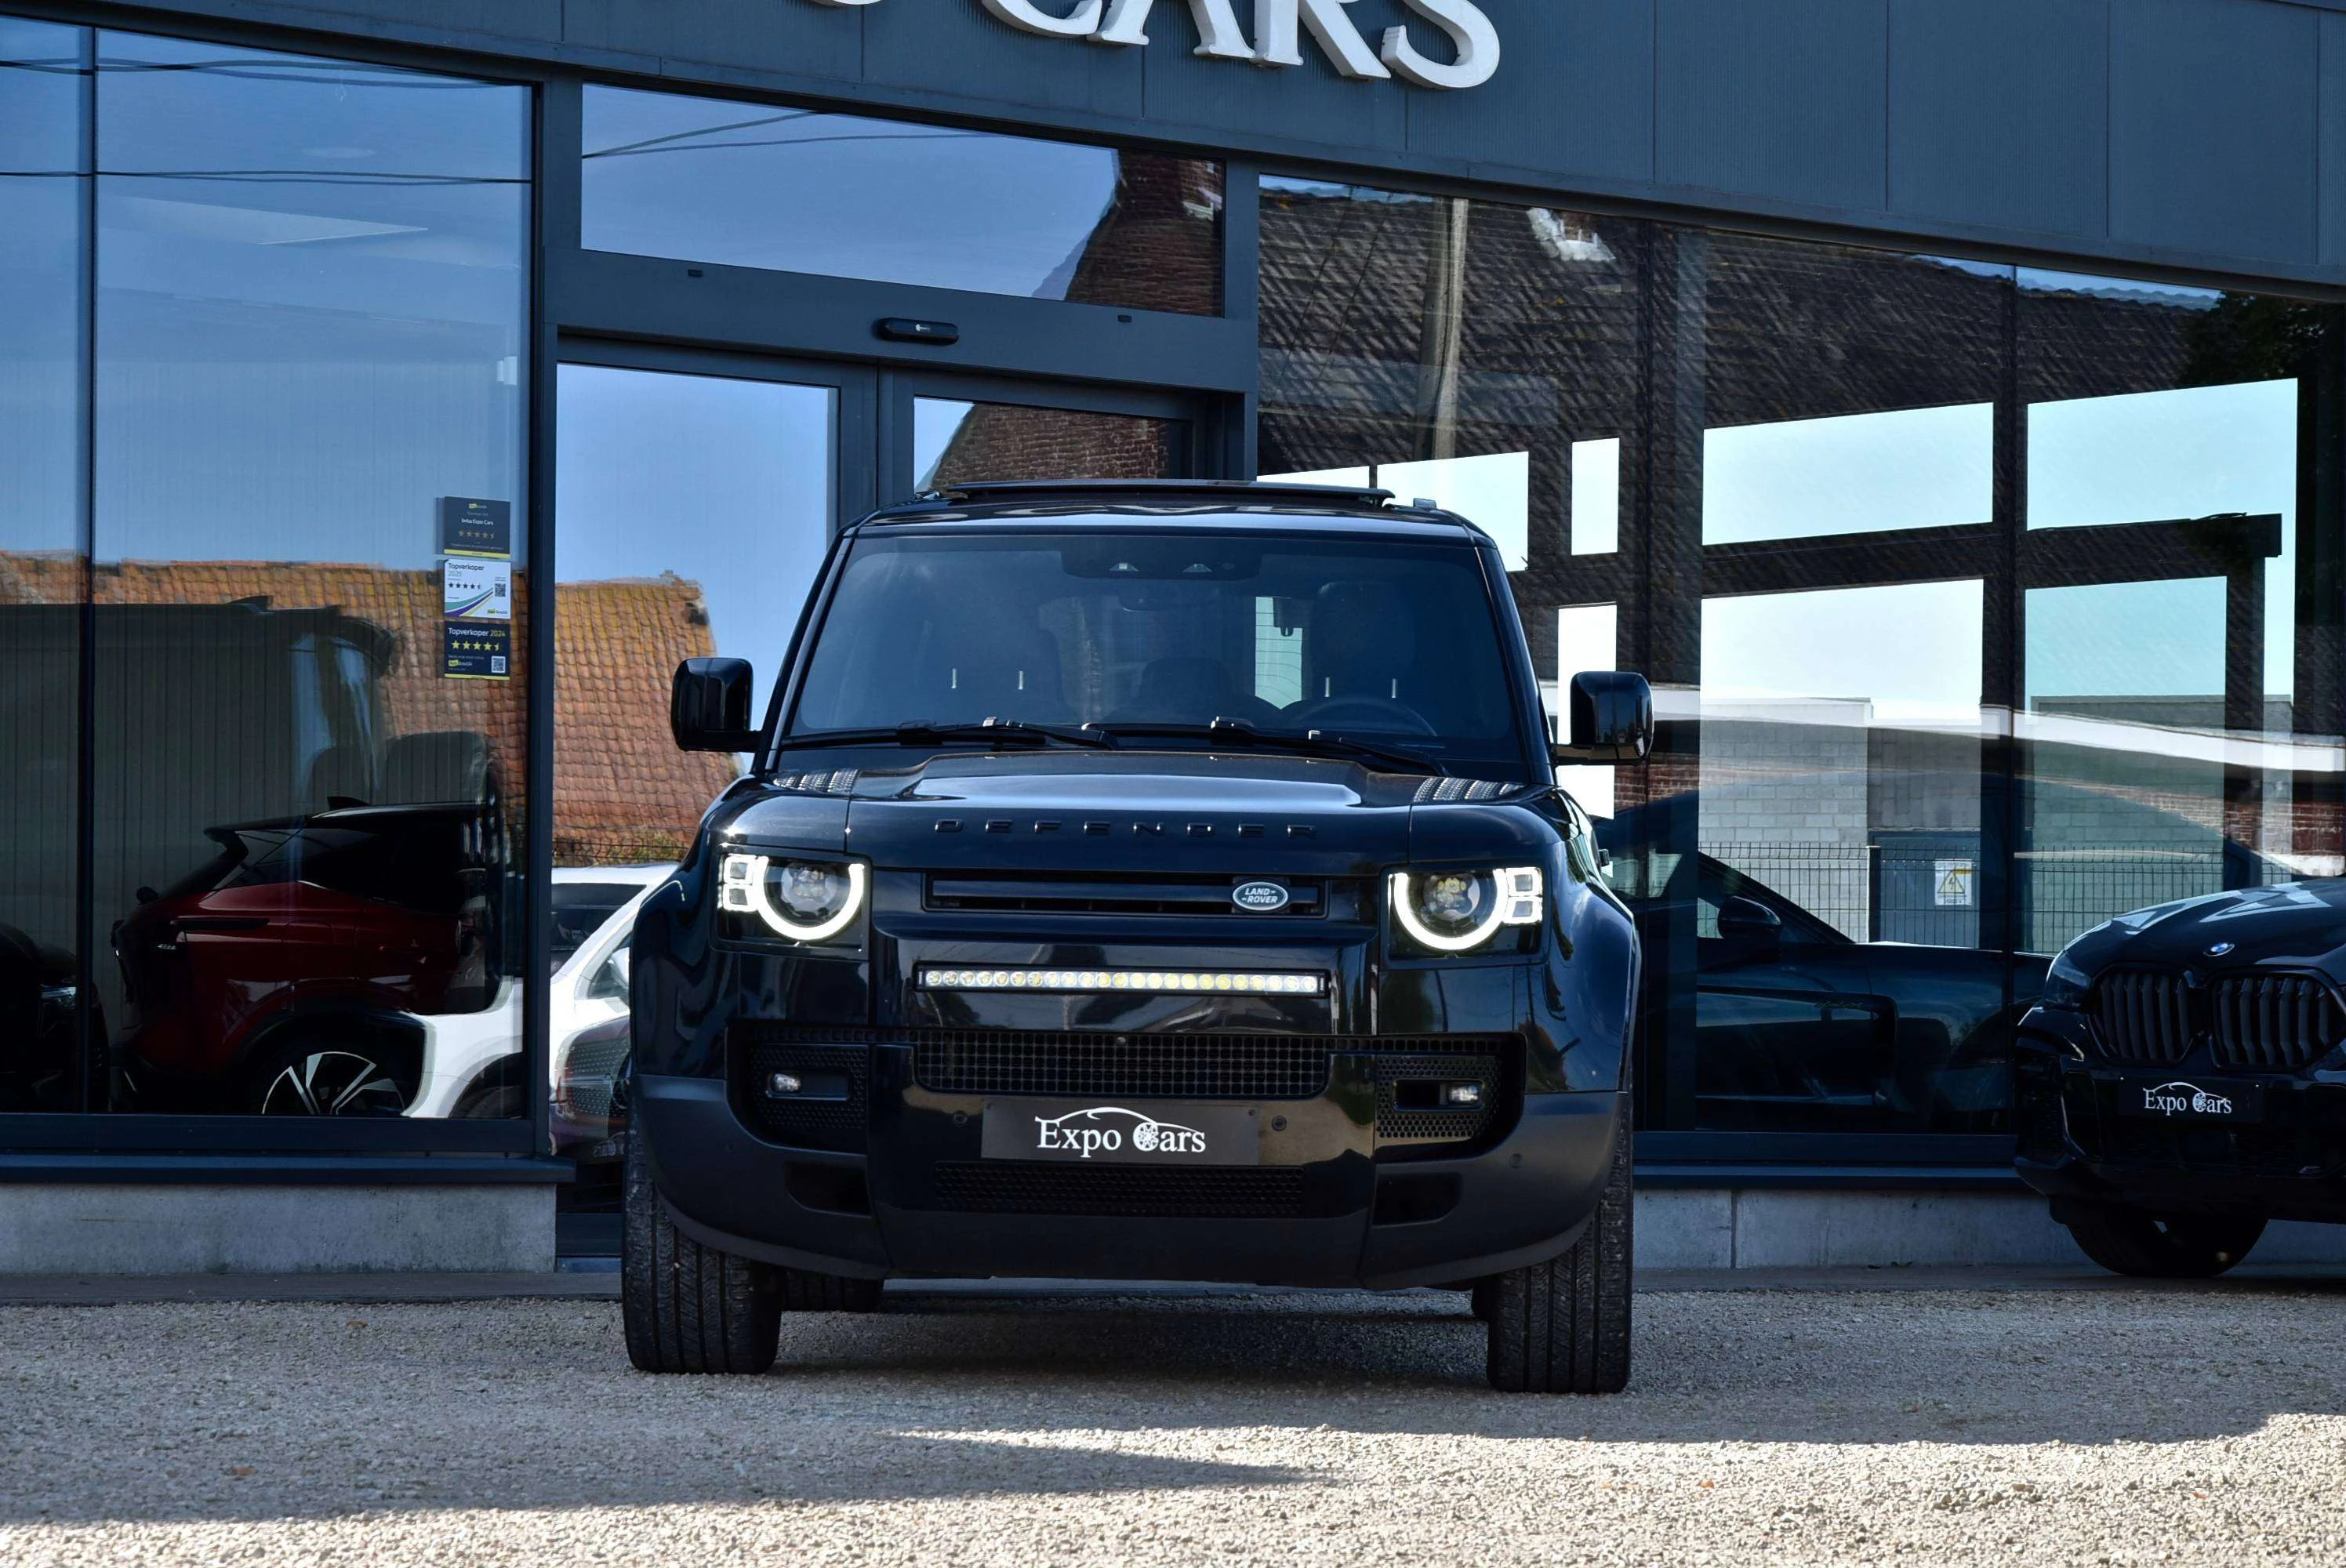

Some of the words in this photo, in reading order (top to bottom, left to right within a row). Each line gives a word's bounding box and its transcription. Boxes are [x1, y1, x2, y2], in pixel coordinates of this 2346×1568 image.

[448, 562, 485, 572] Topverkoper
[448, 627, 489, 637] Topverkoper
[490, 629, 506, 637] 2024
[934, 818, 1317, 837] DEFENDER
[2144, 1089, 2187, 1116] Expo
[2192, 1092, 2232, 1114] Cars
[1035, 1119, 1121, 1158] Expo
[1133, 1122, 1207, 1153] Cars
